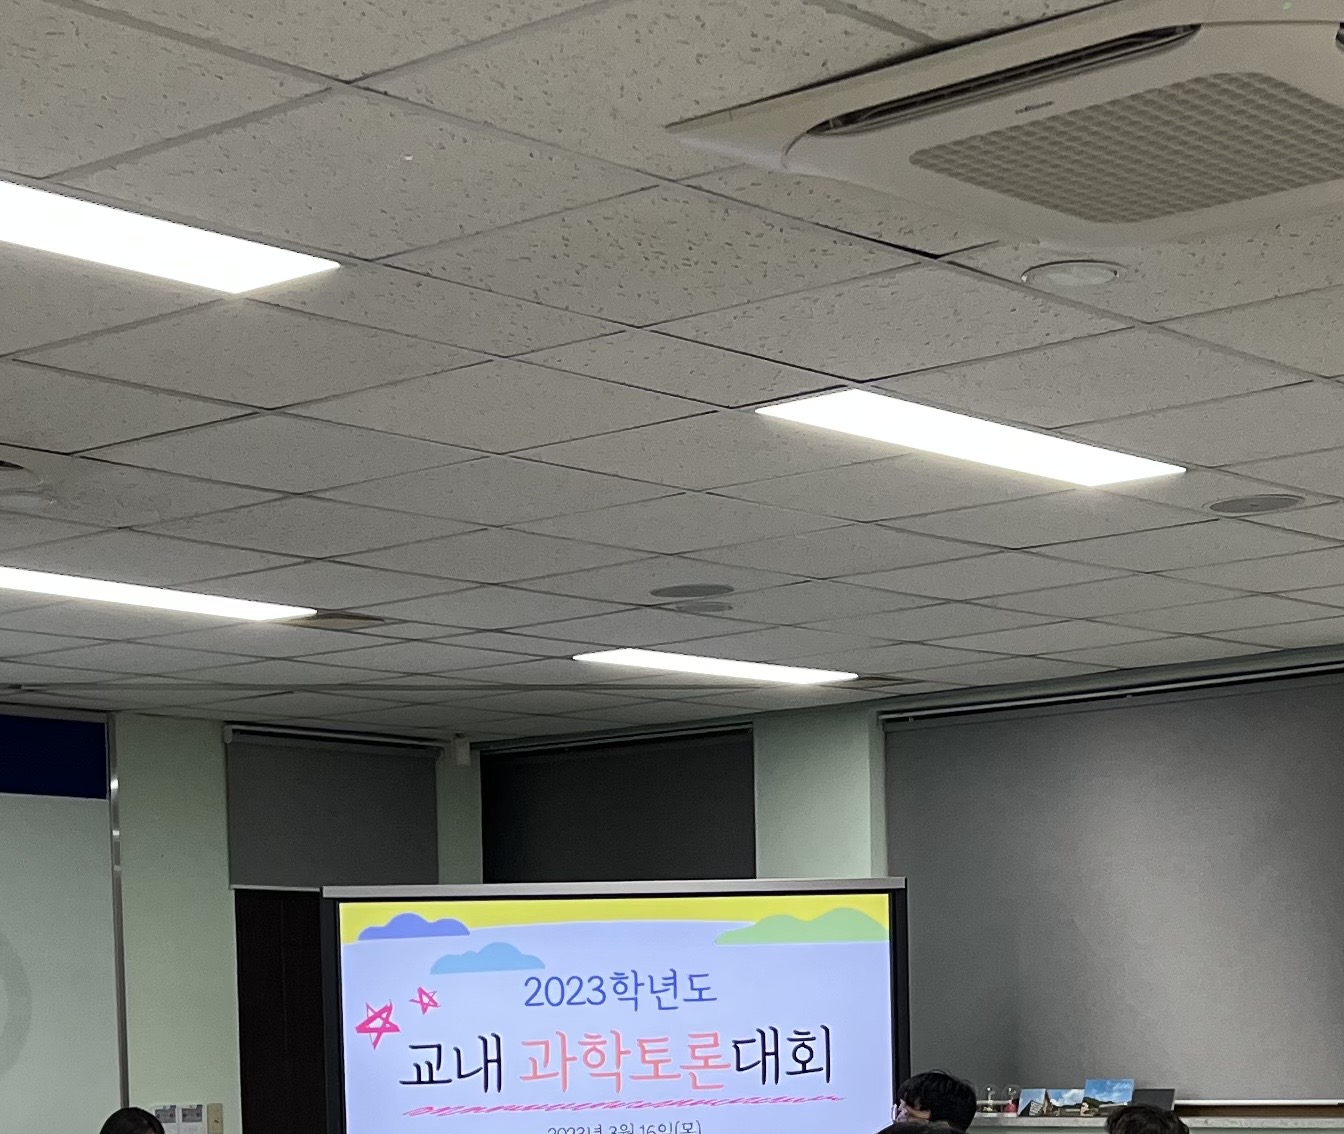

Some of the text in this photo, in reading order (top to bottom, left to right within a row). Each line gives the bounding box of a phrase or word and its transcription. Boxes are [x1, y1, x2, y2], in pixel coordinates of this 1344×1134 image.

[524, 968, 718, 1012] 2023학년도
[399, 1024, 832, 1093] 교내 과학토론대회
